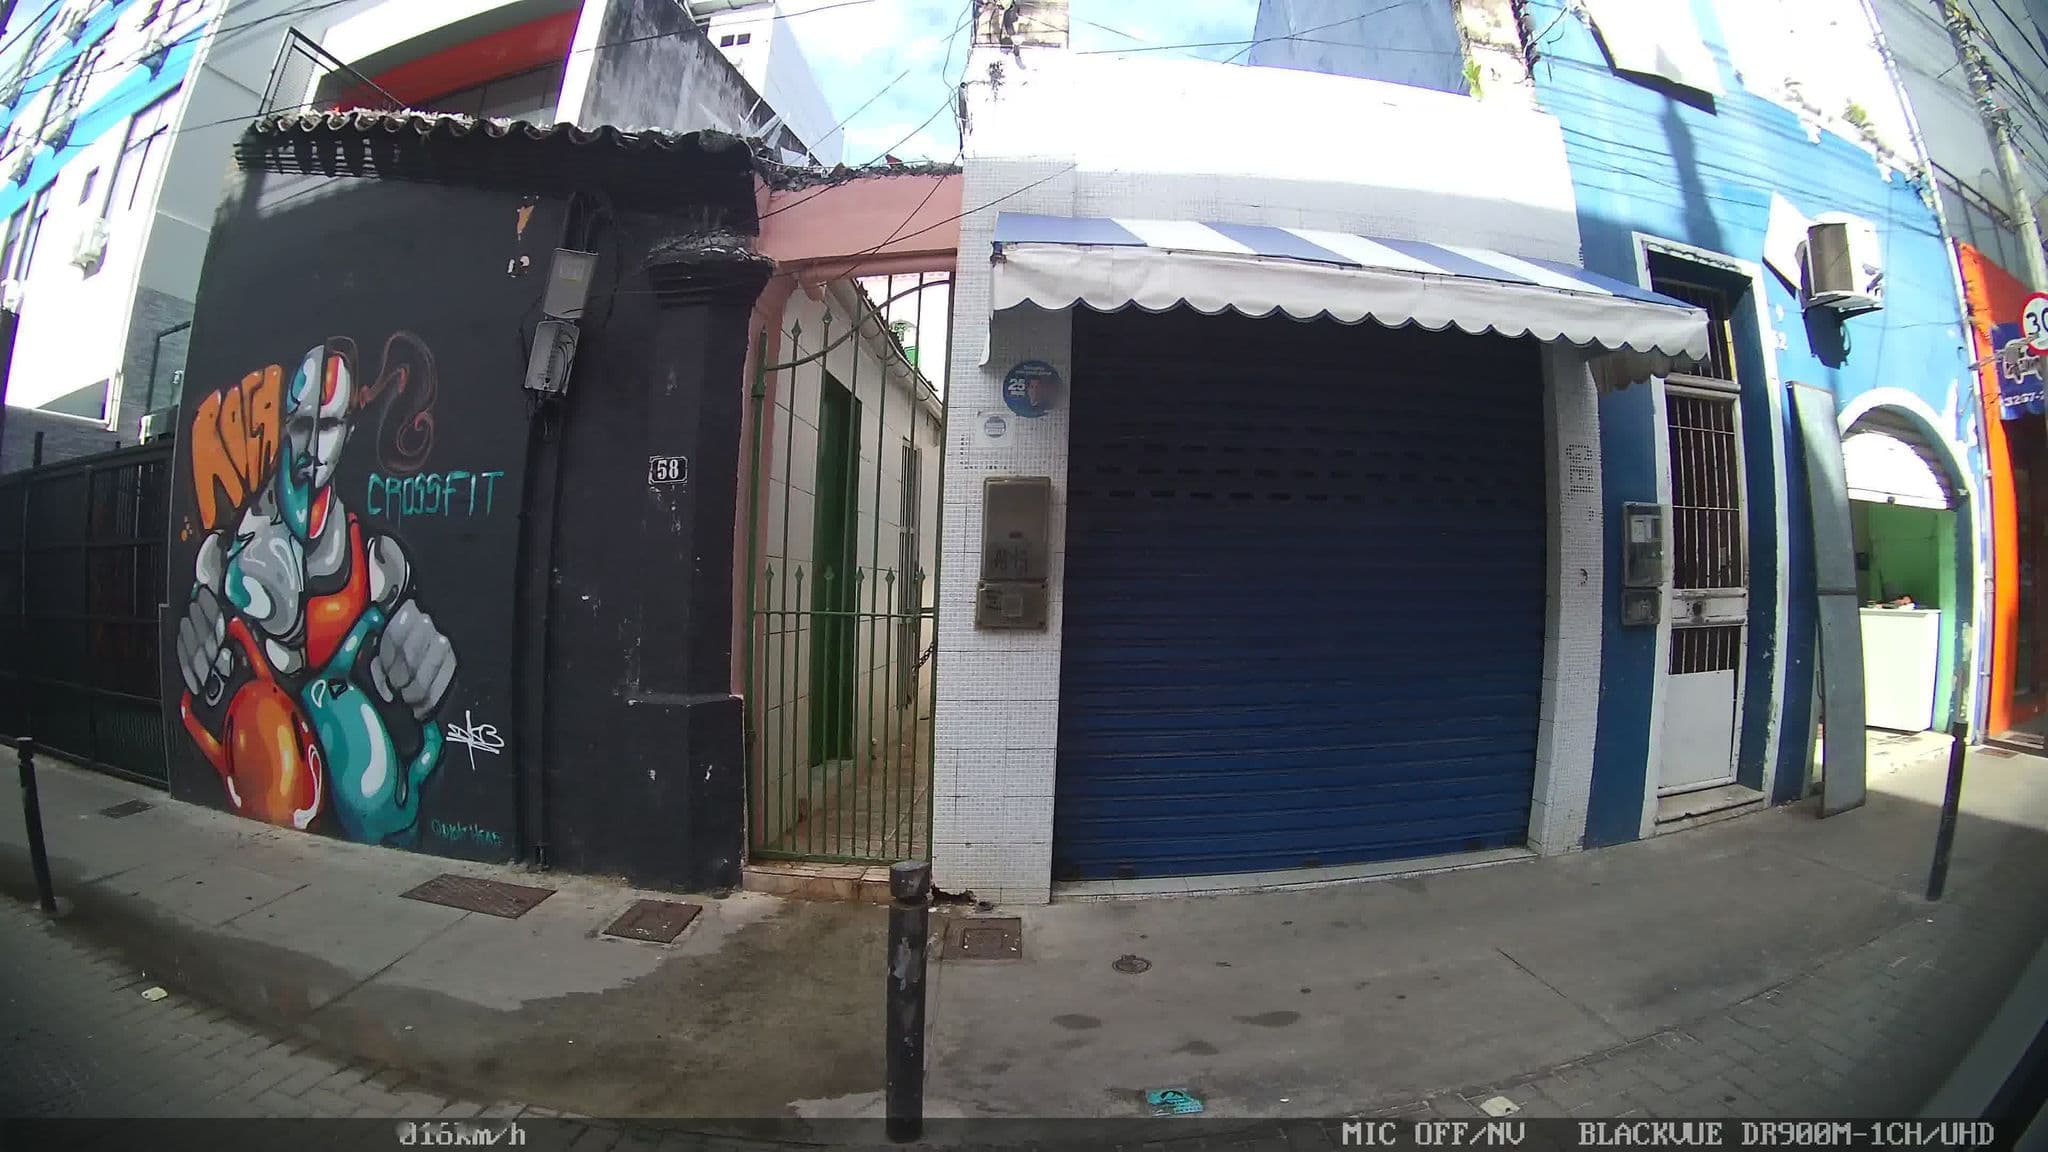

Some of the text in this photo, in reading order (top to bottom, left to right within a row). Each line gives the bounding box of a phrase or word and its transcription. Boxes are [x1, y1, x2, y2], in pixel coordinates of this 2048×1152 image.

[1008, 378, 1025, 391] 25
[657, 459, 679, 480] 58
[367, 471, 504, 517] CROSSFIT
